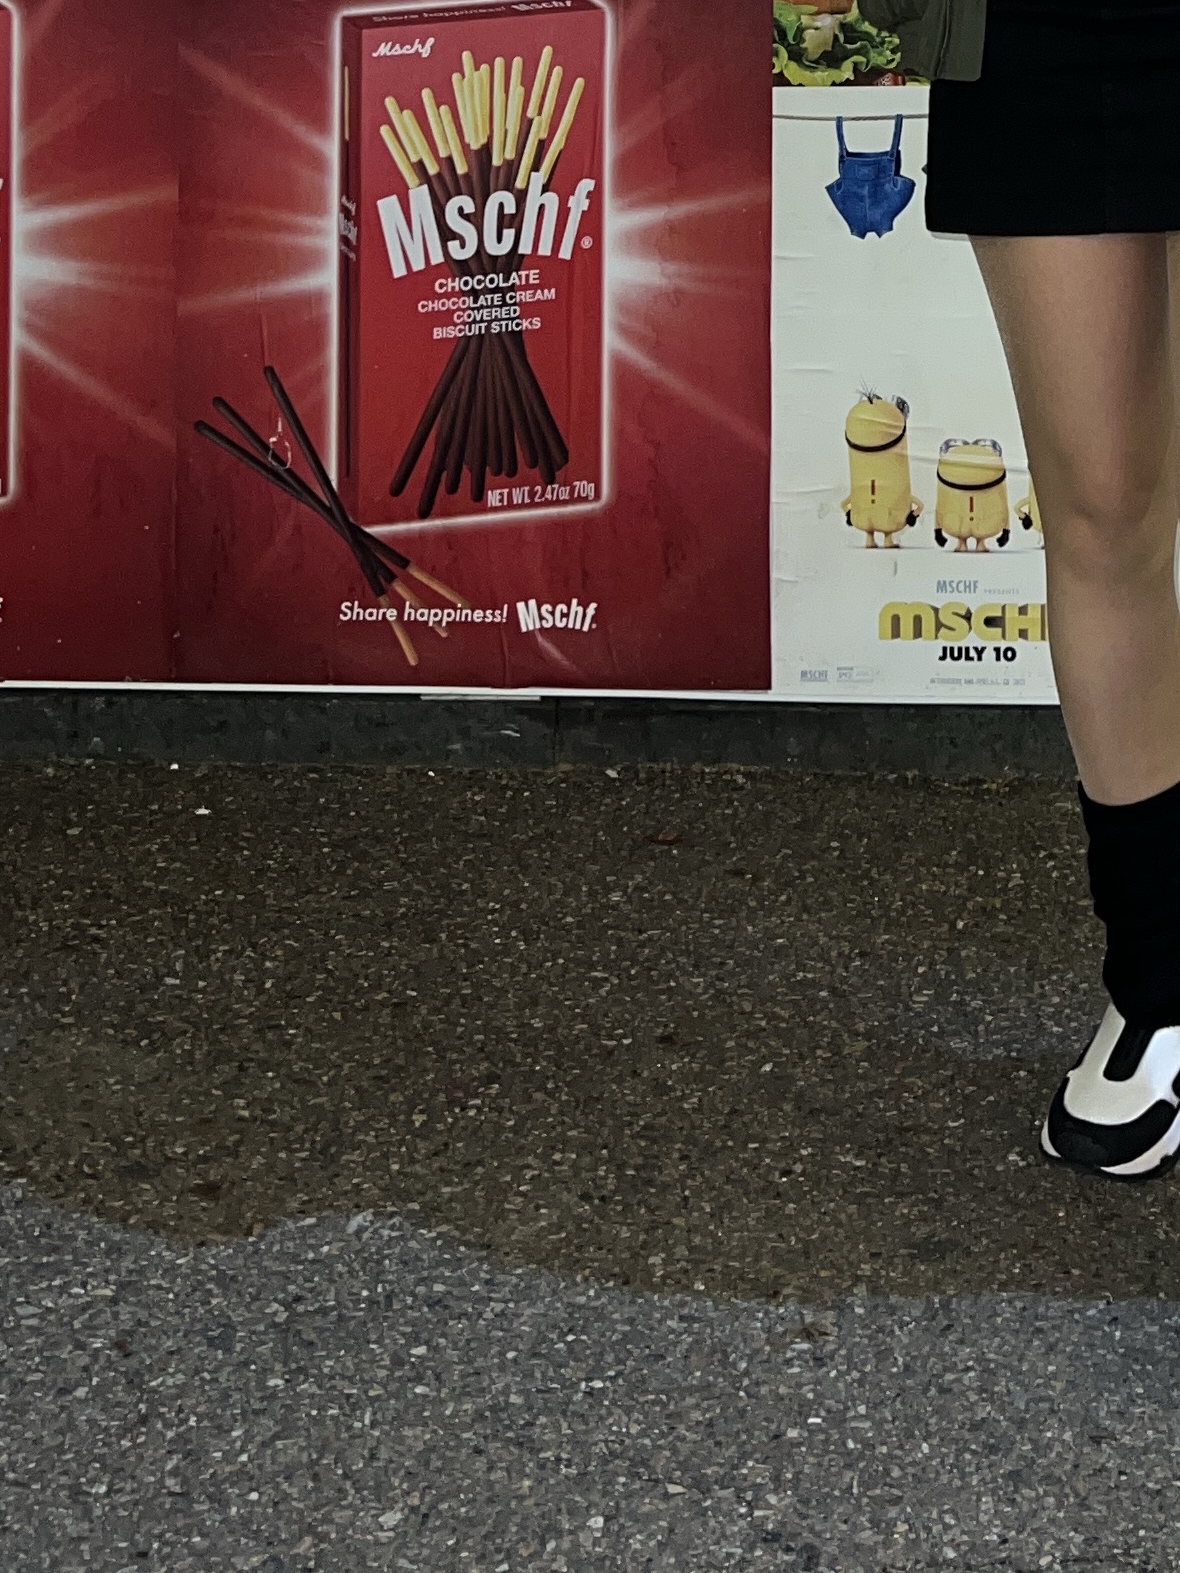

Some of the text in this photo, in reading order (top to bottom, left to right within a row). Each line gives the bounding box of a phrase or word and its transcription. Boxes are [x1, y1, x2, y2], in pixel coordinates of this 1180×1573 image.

[372, 37, 435, 57] Mschf
[434, 269, 540, 294] CHOCOLATE
[417, 288, 556, 313] CHOCOLATE CREAM
[453, 306, 521, 323] COVERED
[432, 317, 541, 340] BISCUIT STICKS
[487, 489, 509, 507] NET
[572, 480, 595, 500] 70g
[936, 580, 979, 594] MSCHF
[339, 601, 398, 621] Share
[403, 601, 508, 627] happiness!
[879, 601, 1049, 642] MSCH
[938, 646, 1017, 662] JULY 10
